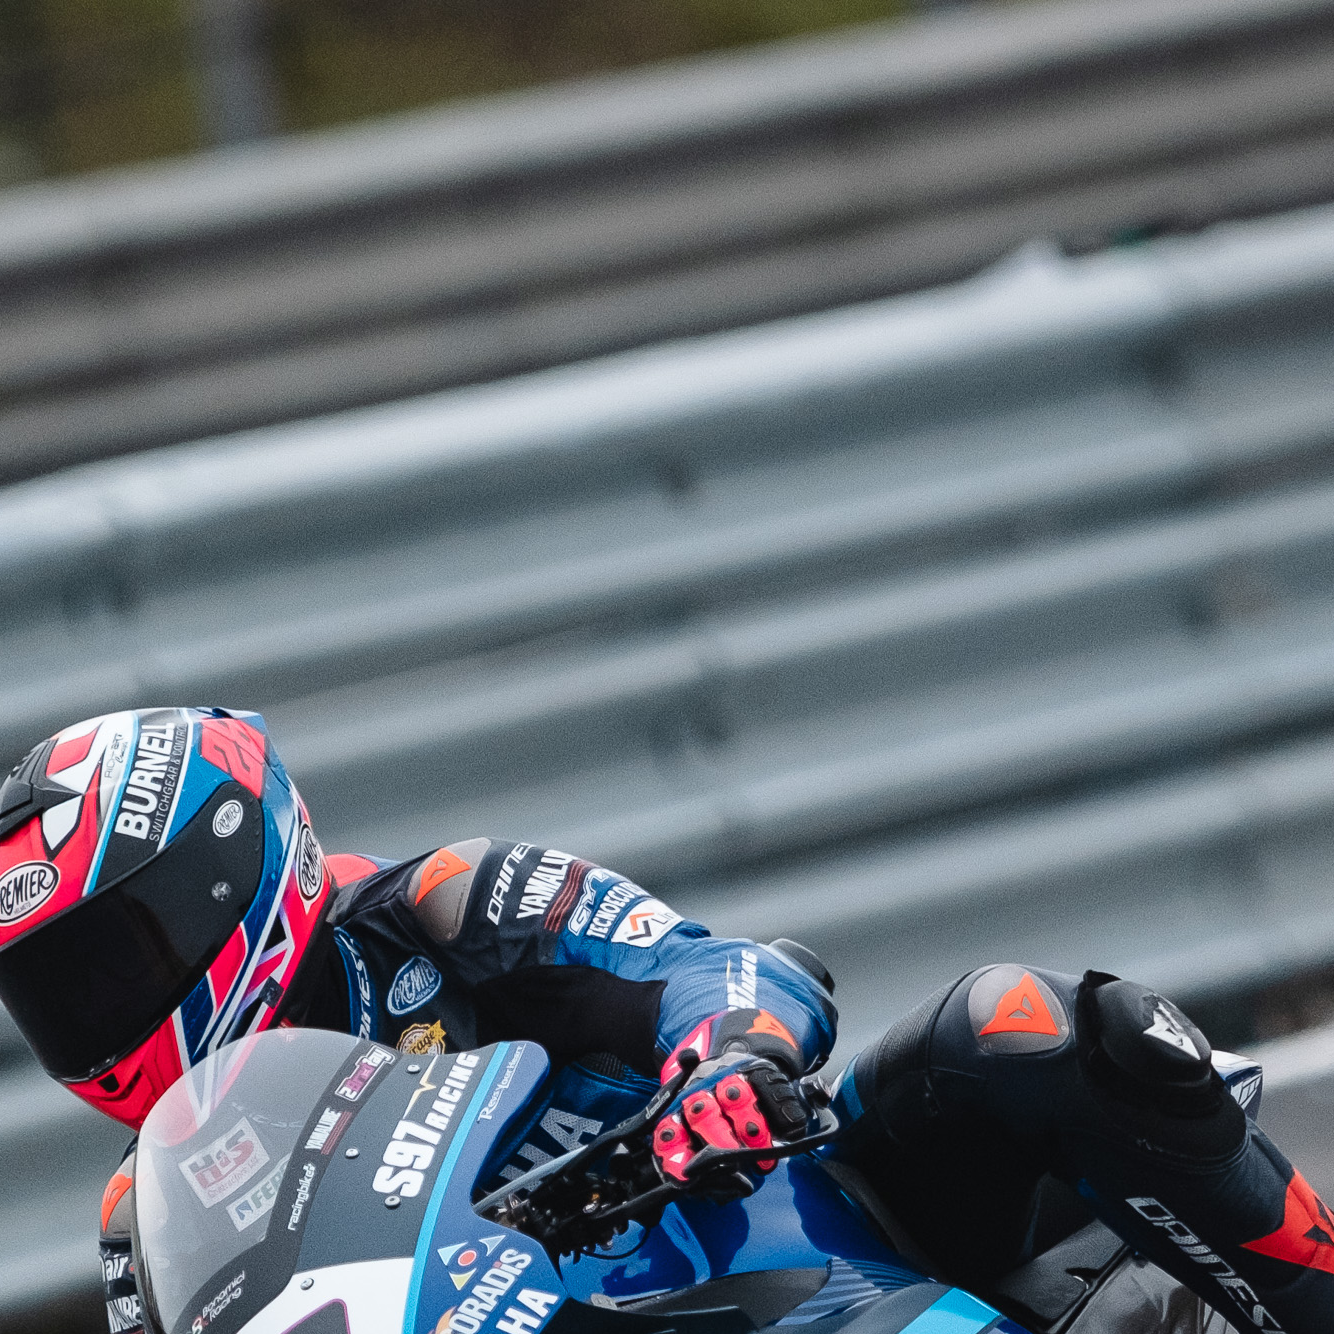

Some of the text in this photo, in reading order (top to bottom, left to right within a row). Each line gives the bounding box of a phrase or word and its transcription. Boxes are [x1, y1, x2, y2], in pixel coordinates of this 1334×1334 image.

[114, 723, 175, 840] BURNELL
[149, 764, 178, 842] SWITCHGEAR
[170, 756, 182, 766] &
[372, 1052, 480, 1198] S97 RACING
